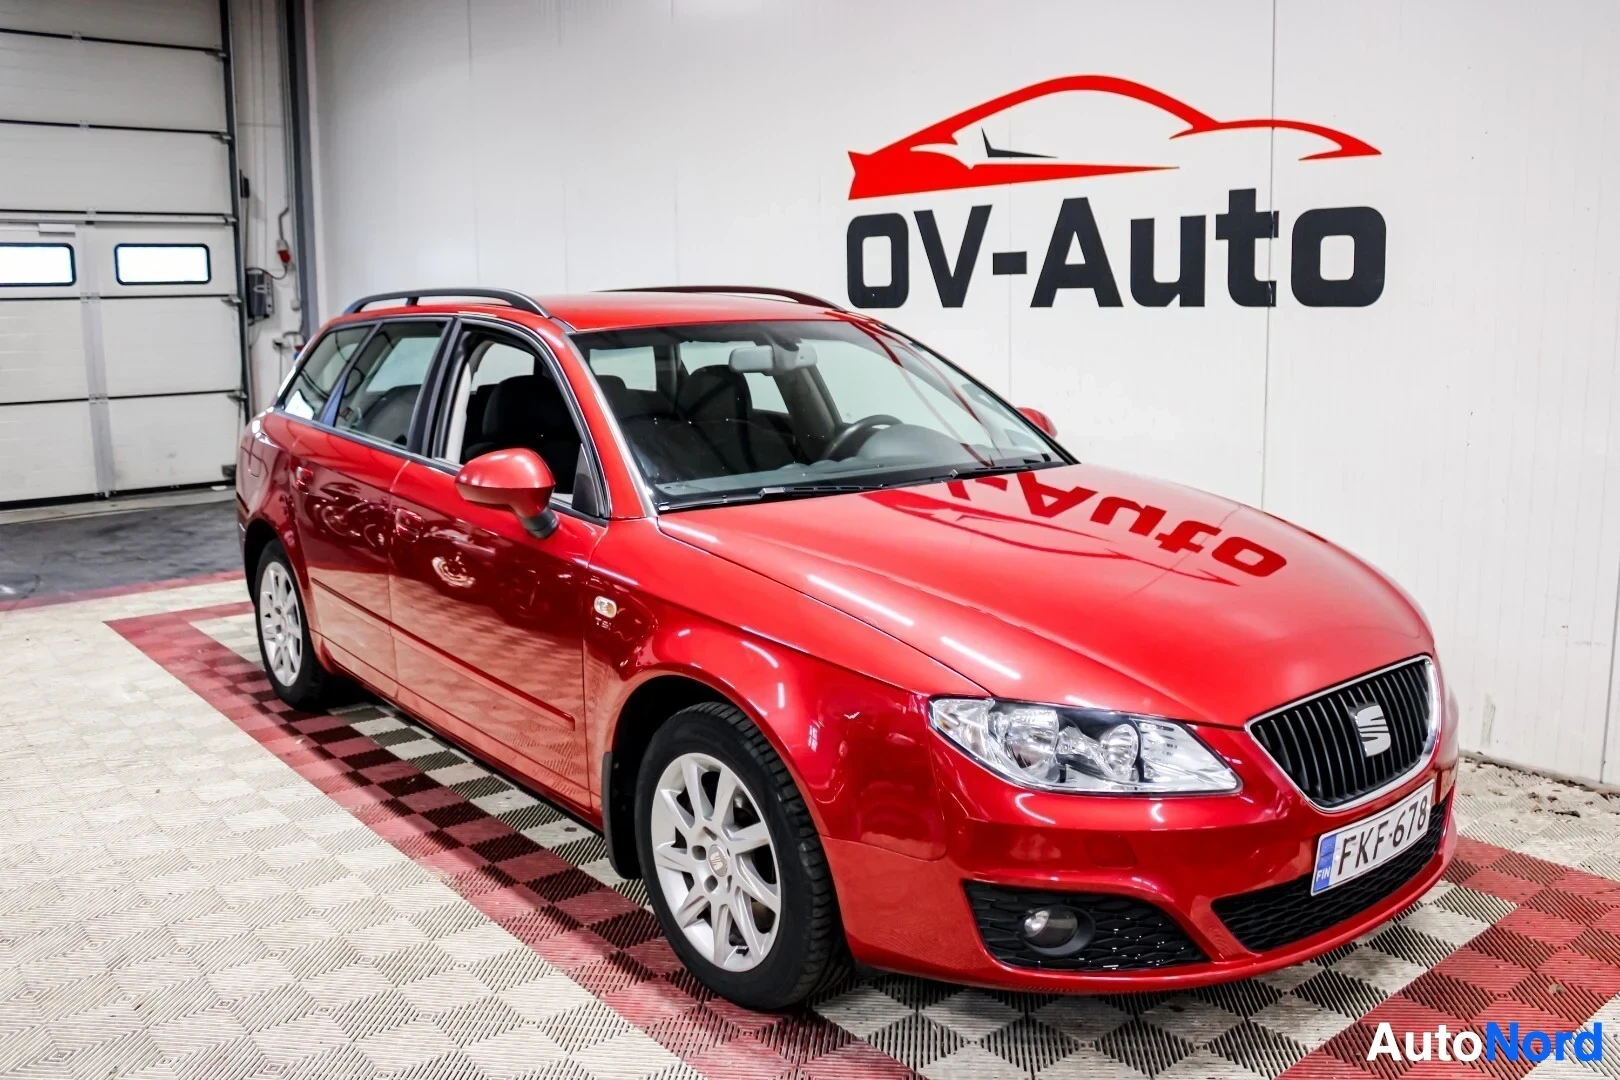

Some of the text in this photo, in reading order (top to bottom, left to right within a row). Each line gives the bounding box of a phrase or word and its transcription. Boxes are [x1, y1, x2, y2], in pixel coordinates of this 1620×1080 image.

[846, 188, 1387, 308] OV-Auto
[1315, 866, 1331, 882] FIN
[1337, 795, 1428, 876] FKF-678
